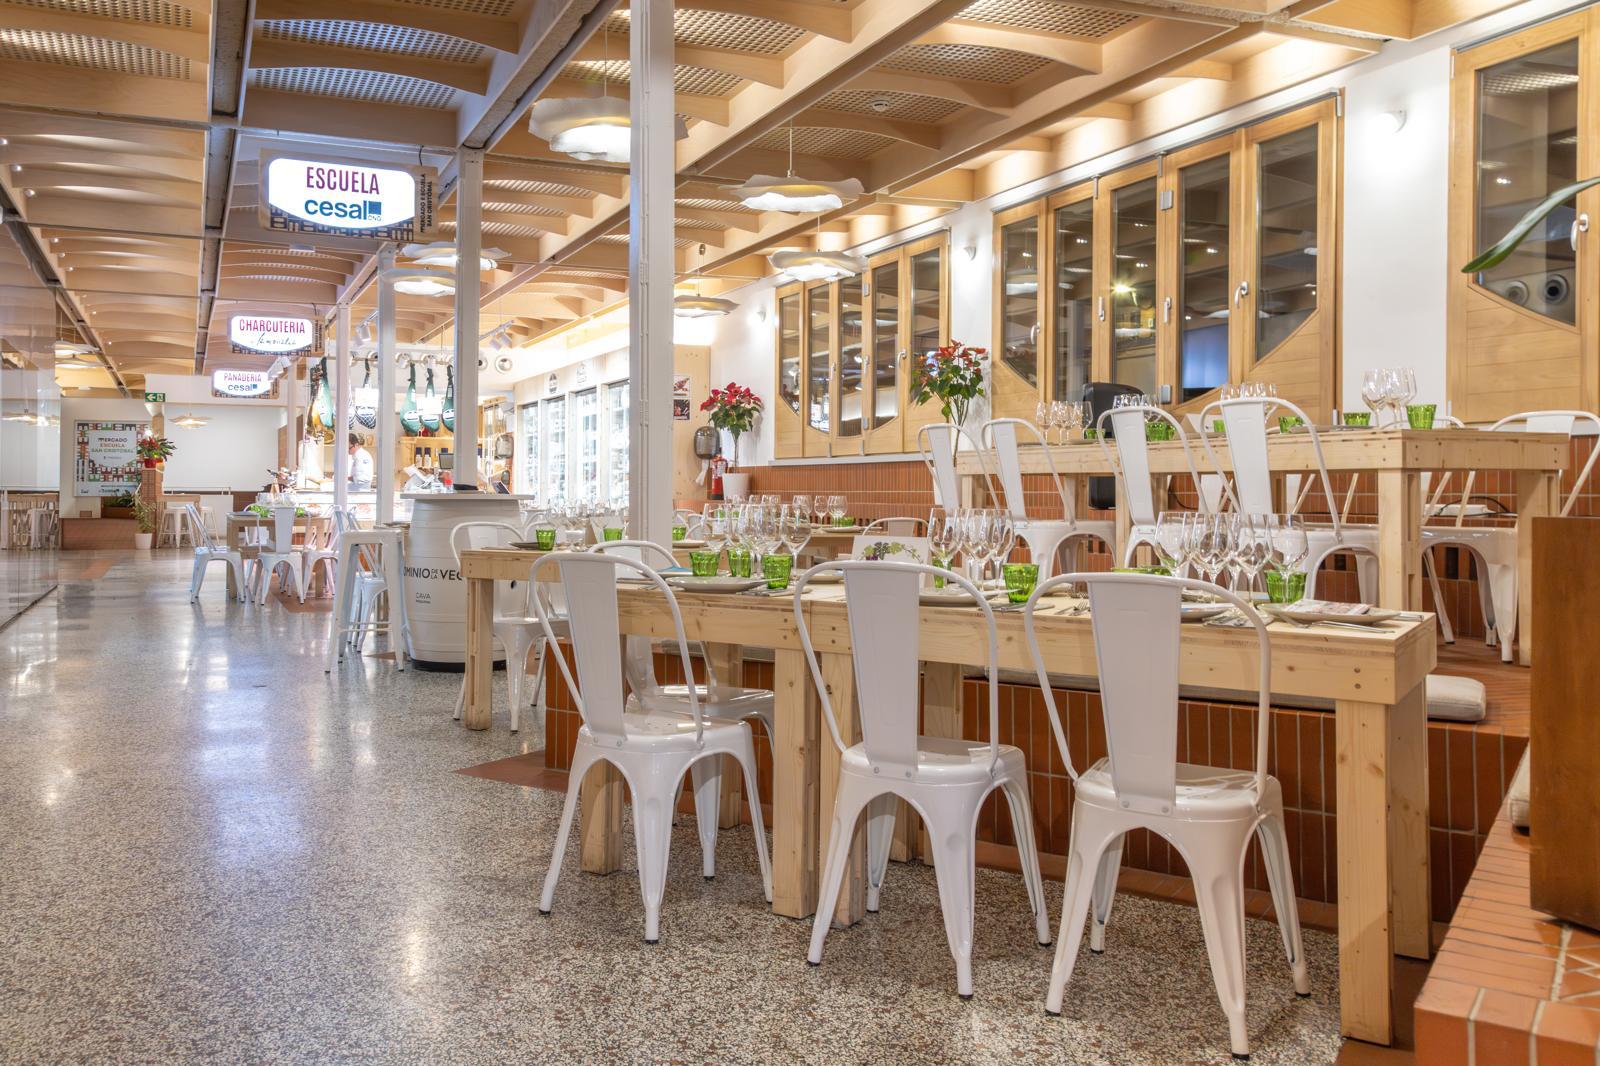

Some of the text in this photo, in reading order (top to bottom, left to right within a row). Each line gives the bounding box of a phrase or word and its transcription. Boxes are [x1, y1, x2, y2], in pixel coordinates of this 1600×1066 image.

[306, 166, 380, 195] ESCUELA
[304, 199, 367, 220] cesal
[227, 383, 253, 392] cesal
